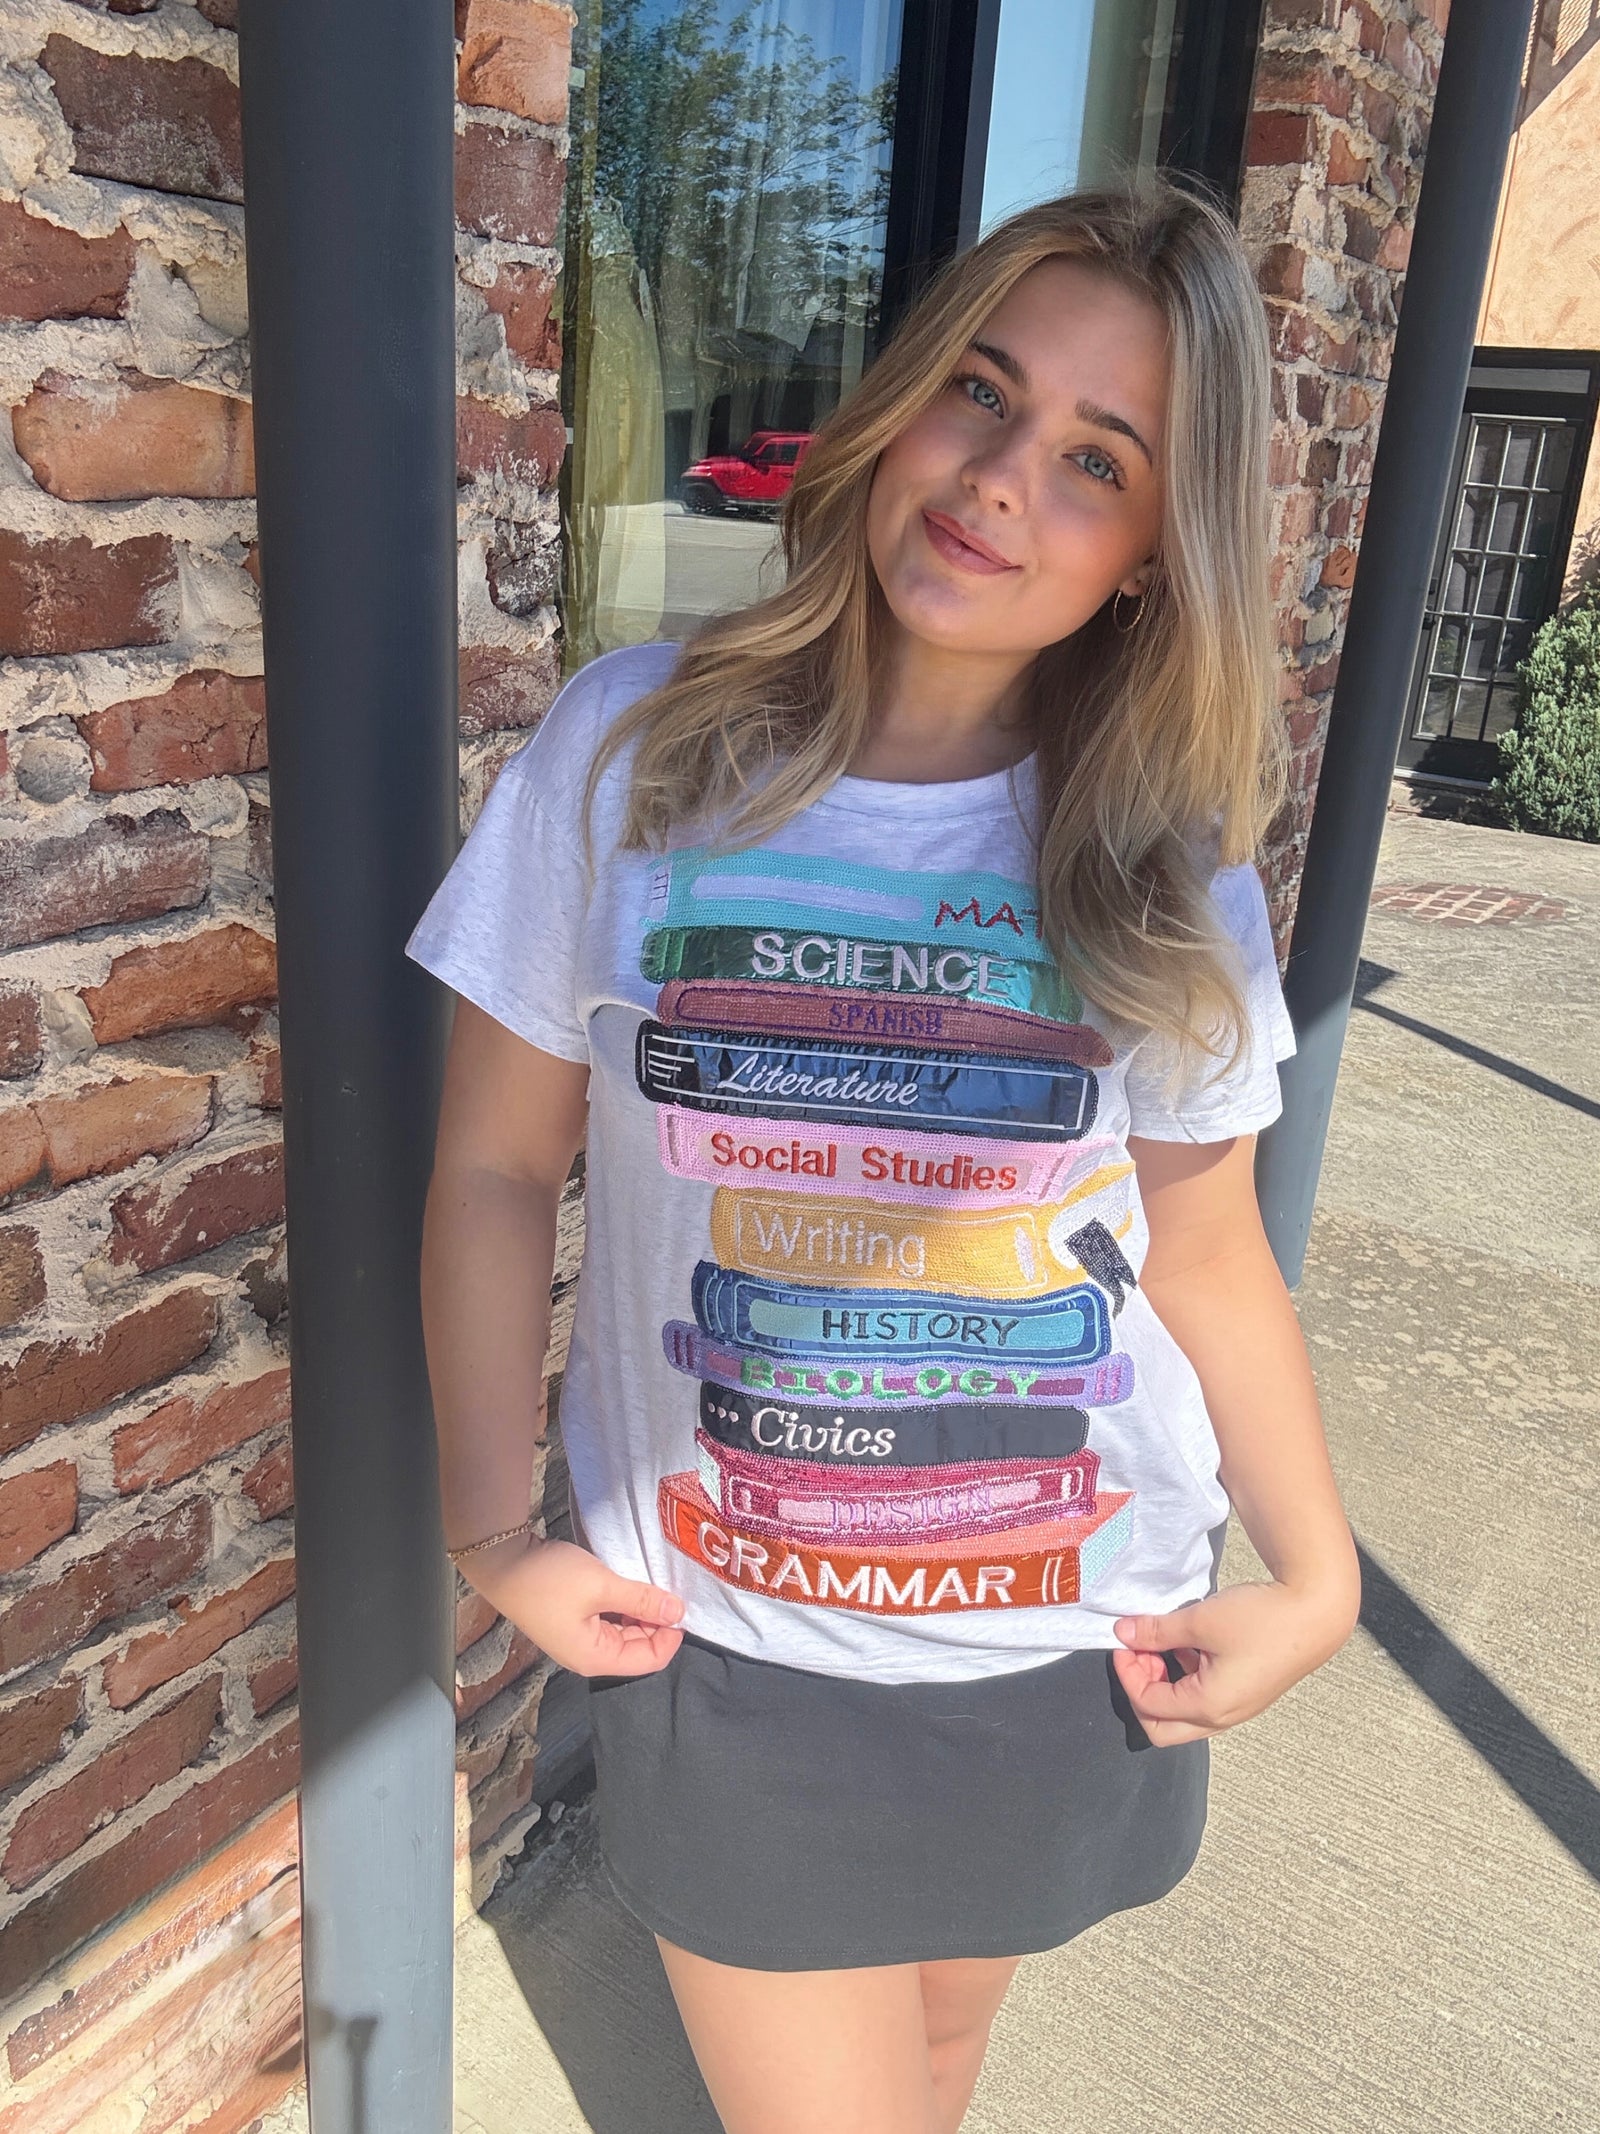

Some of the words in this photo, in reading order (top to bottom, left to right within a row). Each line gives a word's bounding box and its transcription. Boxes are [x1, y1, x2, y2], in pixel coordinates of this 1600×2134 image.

[751, 932, 1011, 998] SCIENCE
[829, 1002, 942, 1035] SPANISH
[717, 1053, 919, 1106] Literature
[711, 1132, 837, 1178] Social
[862, 1145, 1018, 1191] Studies
[752, 1210, 926, 1276] Writing
[823, 1309, 1020, 1345] HISTORY
[740, 1357, 1042, 1401] BIOLOGY
[751, 1406, 897, 1457] Civics
[831, 1486, 994, 1531] DESIGN
[699, 1521, 1016, 1607] GRAMMAR
